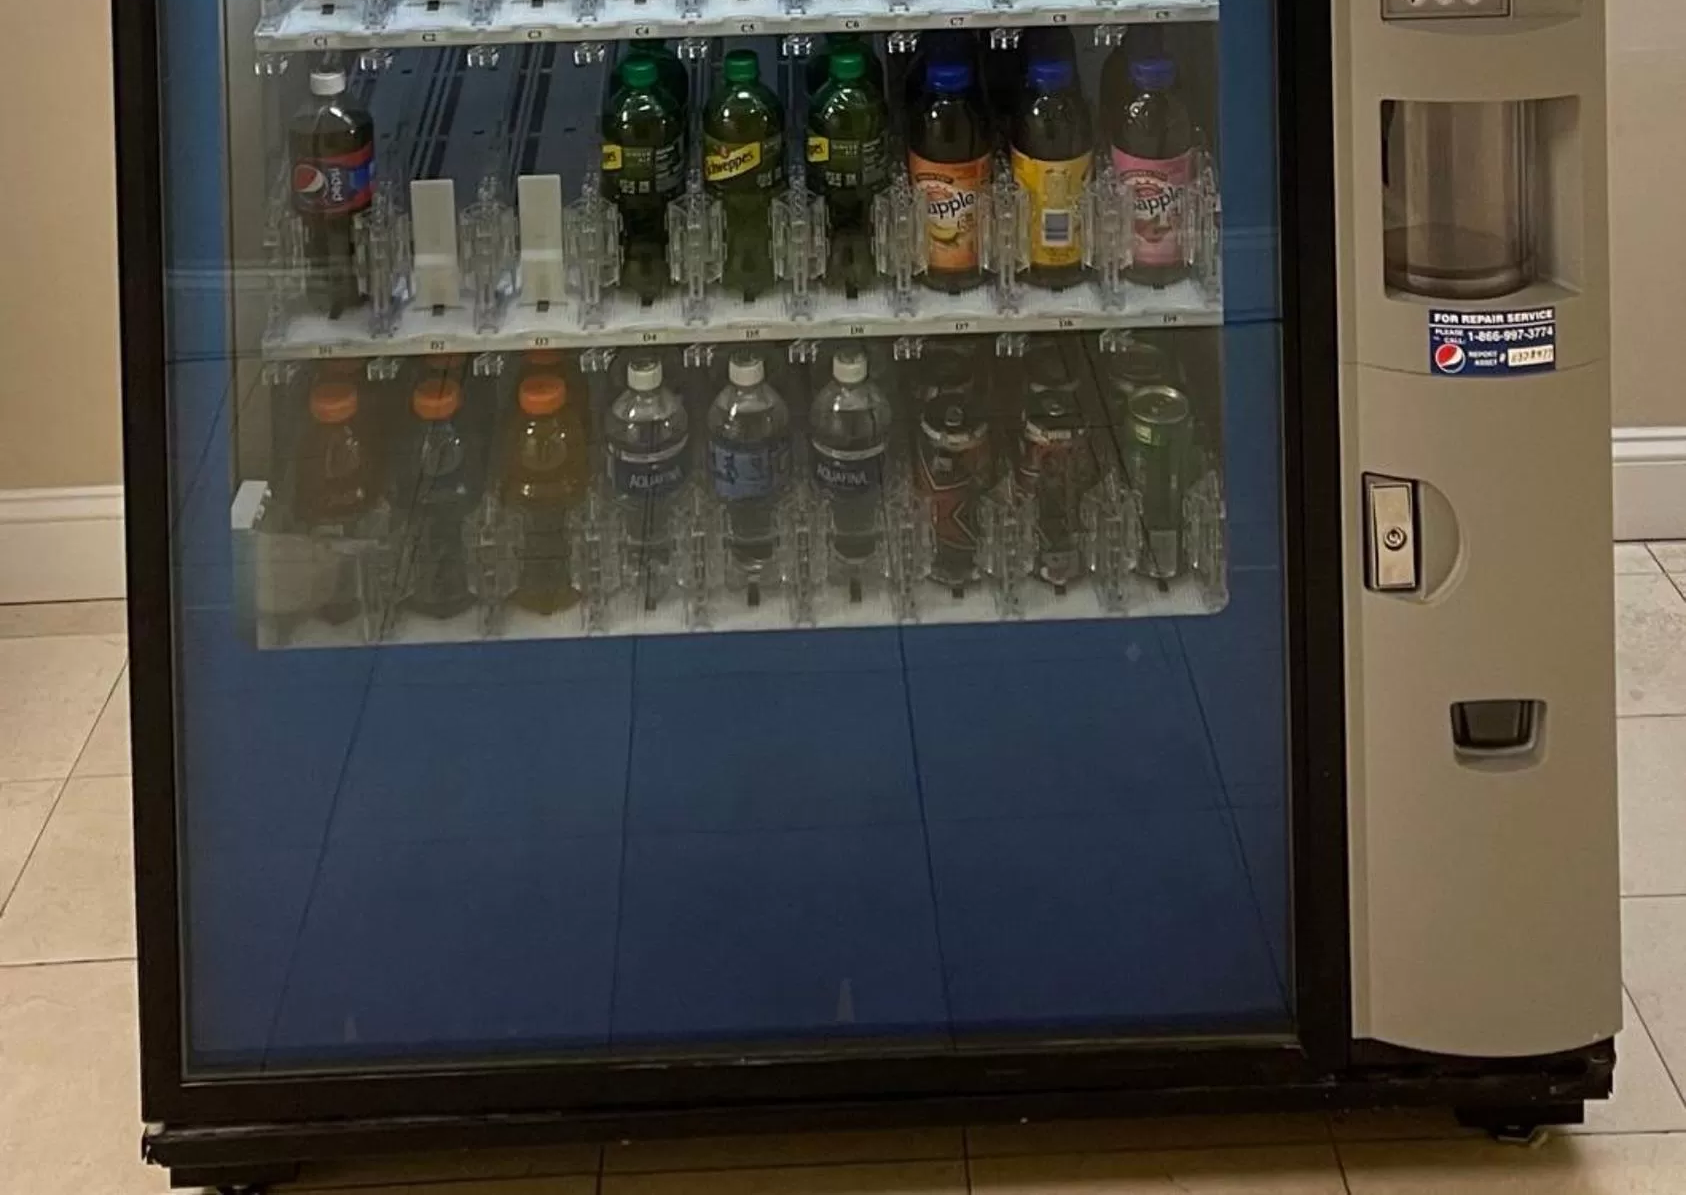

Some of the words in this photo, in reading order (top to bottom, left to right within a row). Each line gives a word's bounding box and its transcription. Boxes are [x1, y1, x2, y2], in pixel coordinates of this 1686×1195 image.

[927, 191, 975, 219] apple
[1434, 313, 1459, 324] FOR
[1461, 314, 1504, 324] REPAIR
[1507, 309, 1553, 323] SERVICE
